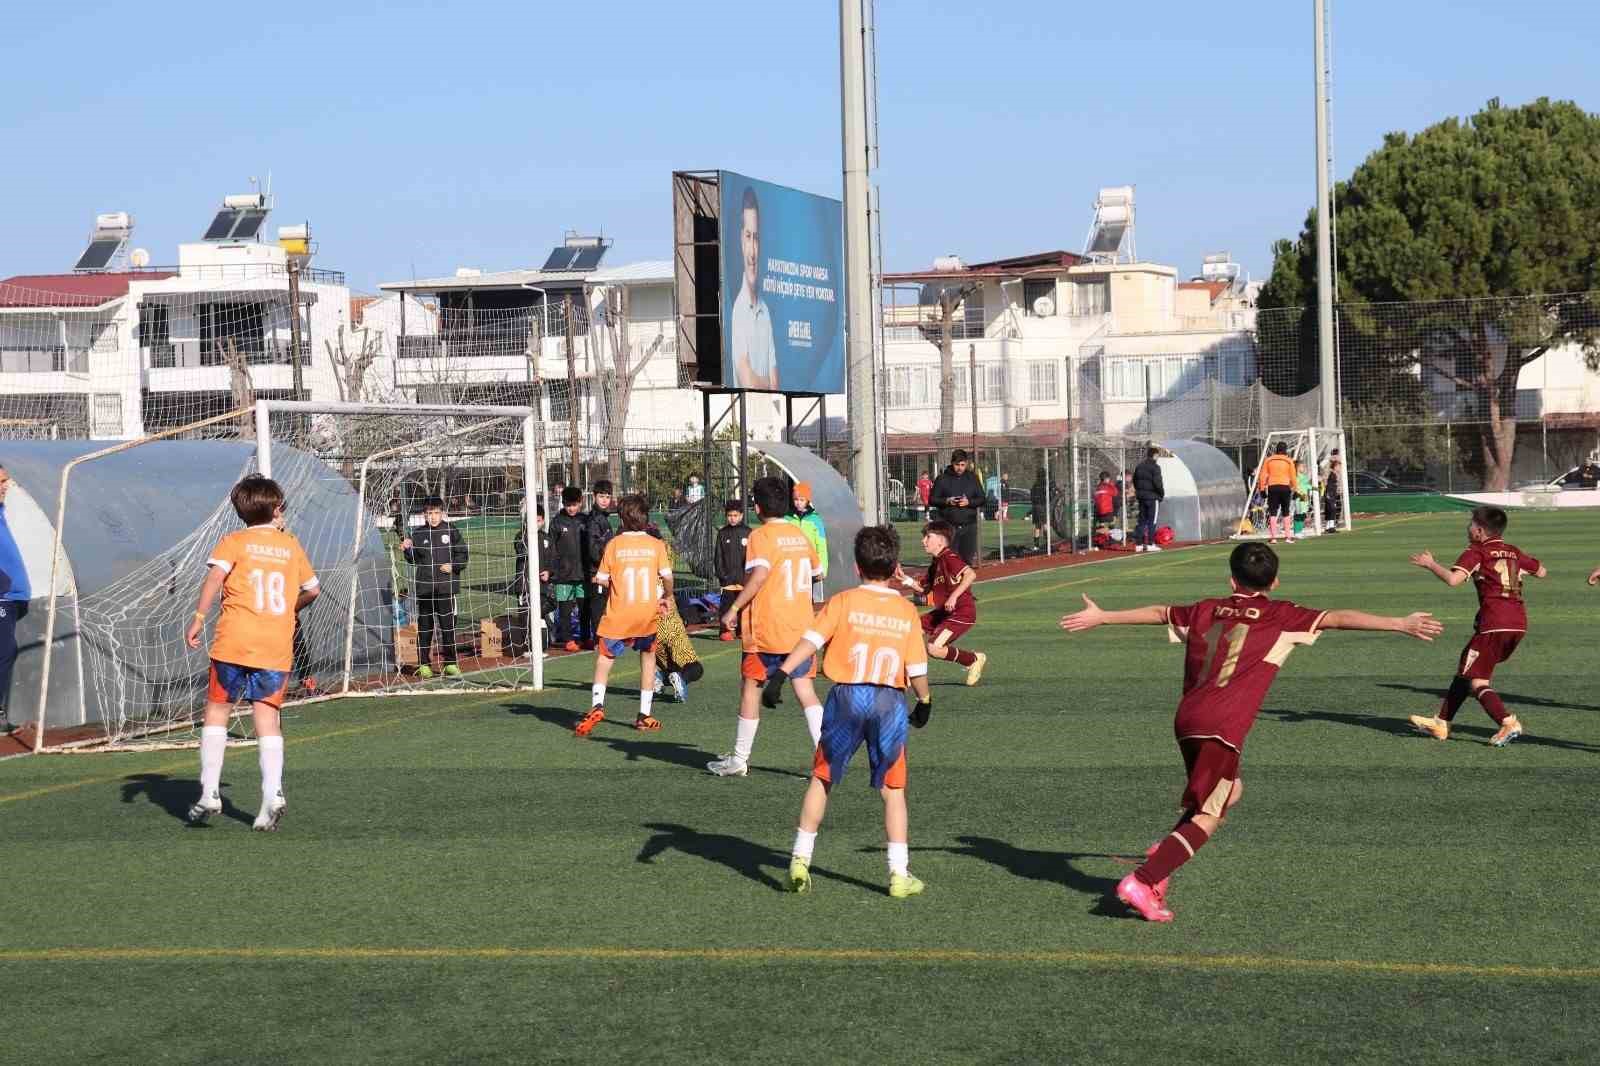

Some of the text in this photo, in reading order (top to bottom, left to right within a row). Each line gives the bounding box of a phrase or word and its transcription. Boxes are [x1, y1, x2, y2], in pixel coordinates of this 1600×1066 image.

[248, 568, 286, 614] 18
[624, 567, 650, 603] 11
[780, 557, 812, 599] 14
[847, 611, 912, 633] ATAKUM
[849, 643, 900, 687] 10
[1200, 622, 1250, 688] 11
